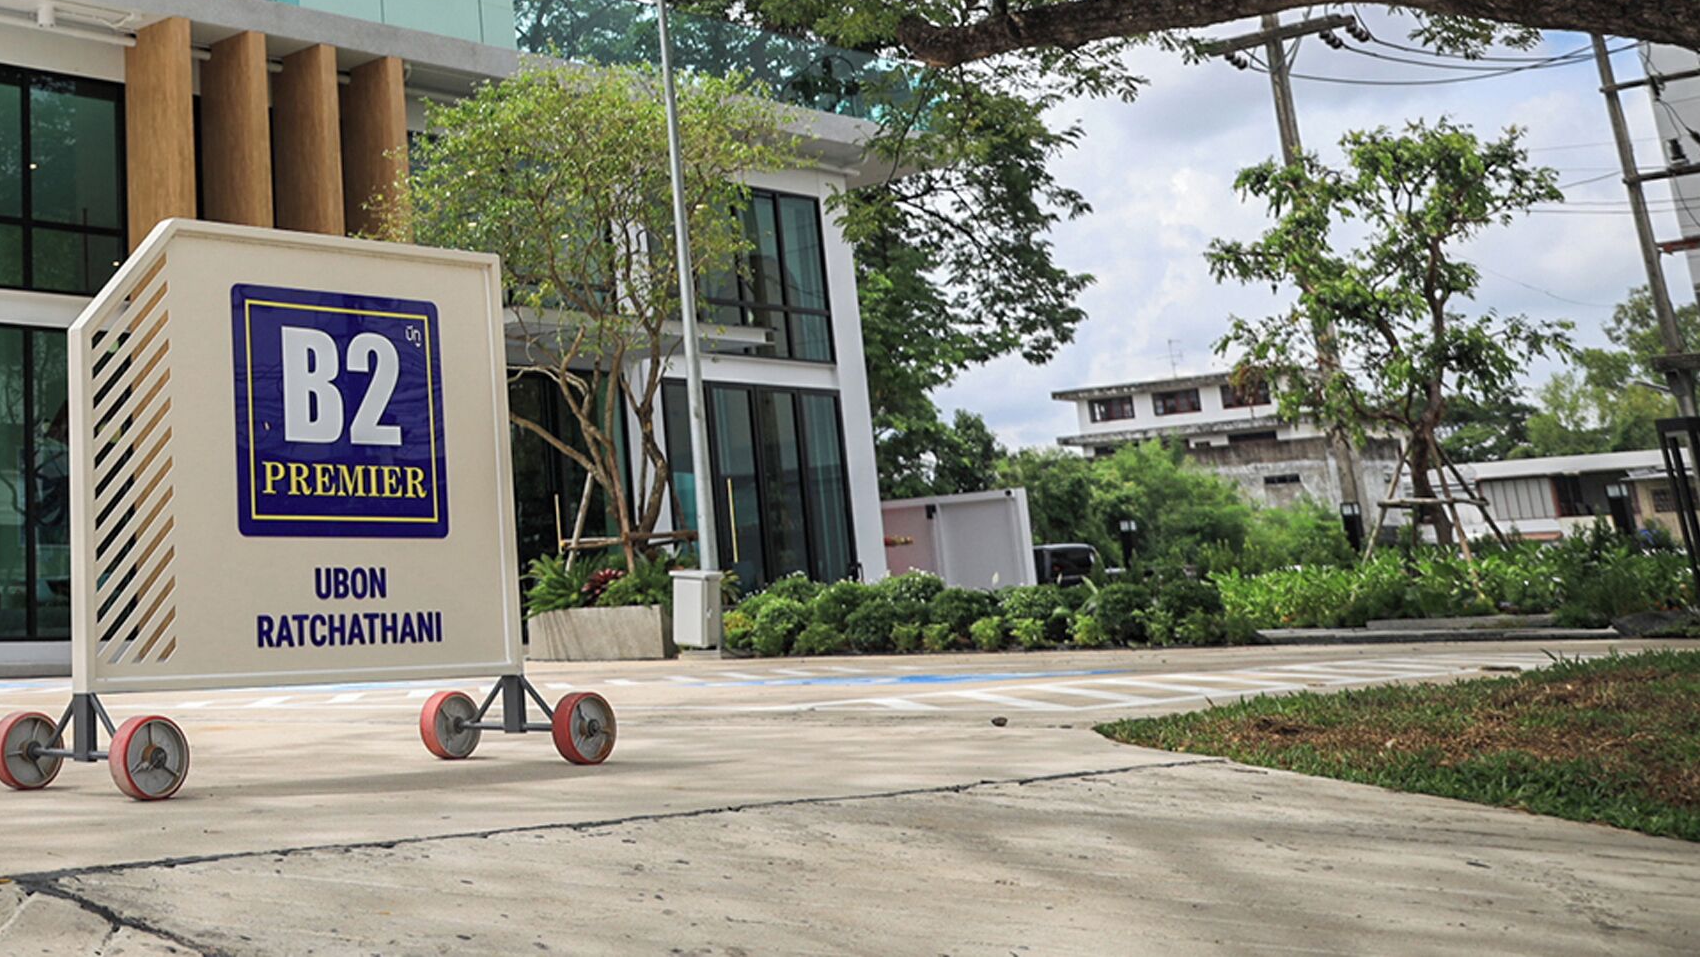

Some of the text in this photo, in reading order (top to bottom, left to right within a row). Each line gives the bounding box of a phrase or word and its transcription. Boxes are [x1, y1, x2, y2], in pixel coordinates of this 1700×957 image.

[281, 325, 402, 446] B2
[261, 461, 427, 498] PREMIER
[314, 566, 387, 600] UBON
[256, 611, 443, 648] RATCHATHANI
